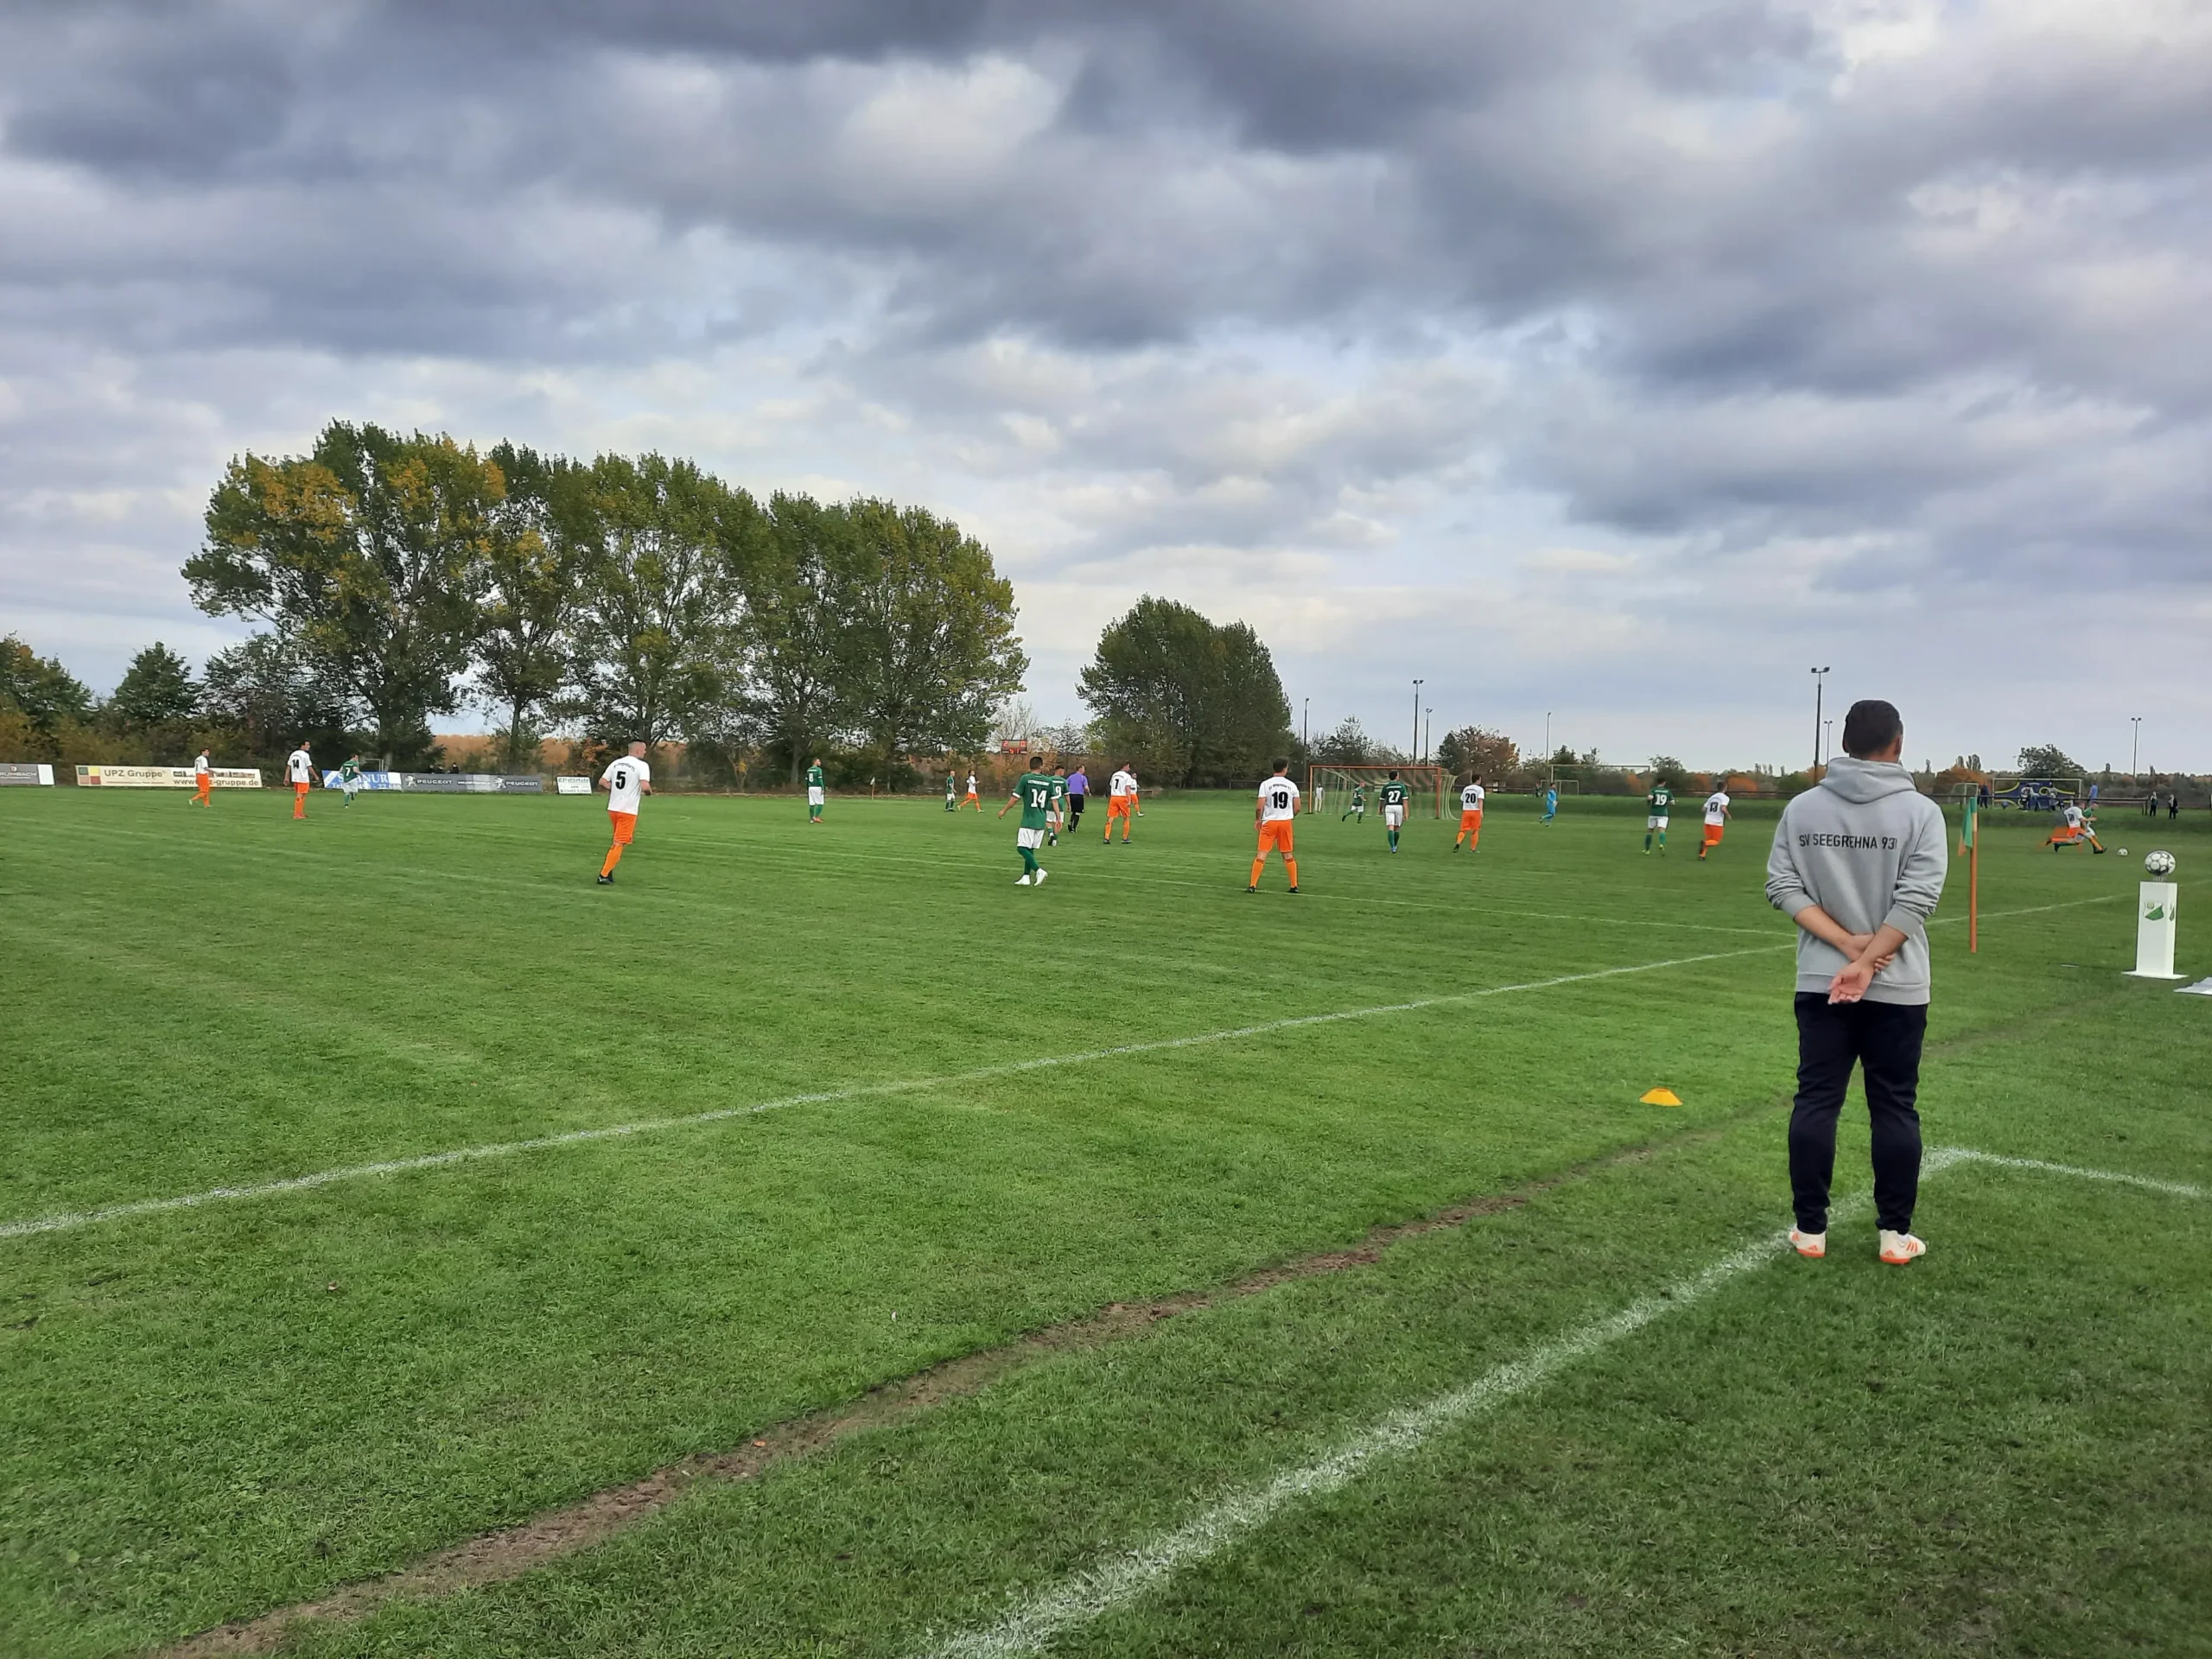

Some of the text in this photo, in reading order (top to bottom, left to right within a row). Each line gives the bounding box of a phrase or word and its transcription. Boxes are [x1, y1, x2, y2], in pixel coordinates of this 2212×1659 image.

[291, 759, 300, 770] 14
[345, 767, 352, 777] 7
[809, 772, 814, 783] 8
[615, 771, 626, 790] 5
[1055, 785, 1062, 797] 9
[1388, 790, 1401, 804] 27
[1031, 788, 1047, 809] 14
[1271, 791, 1288, 810] 19
[1465, 792, 1476, 804] 20
[1655, 793, 1668, 805] 19
[1709, 801, 1719, 813] 13
[1799, 834, 1810, 848] SV
[1813, 834, 1878, 849] SEEGREHNA
